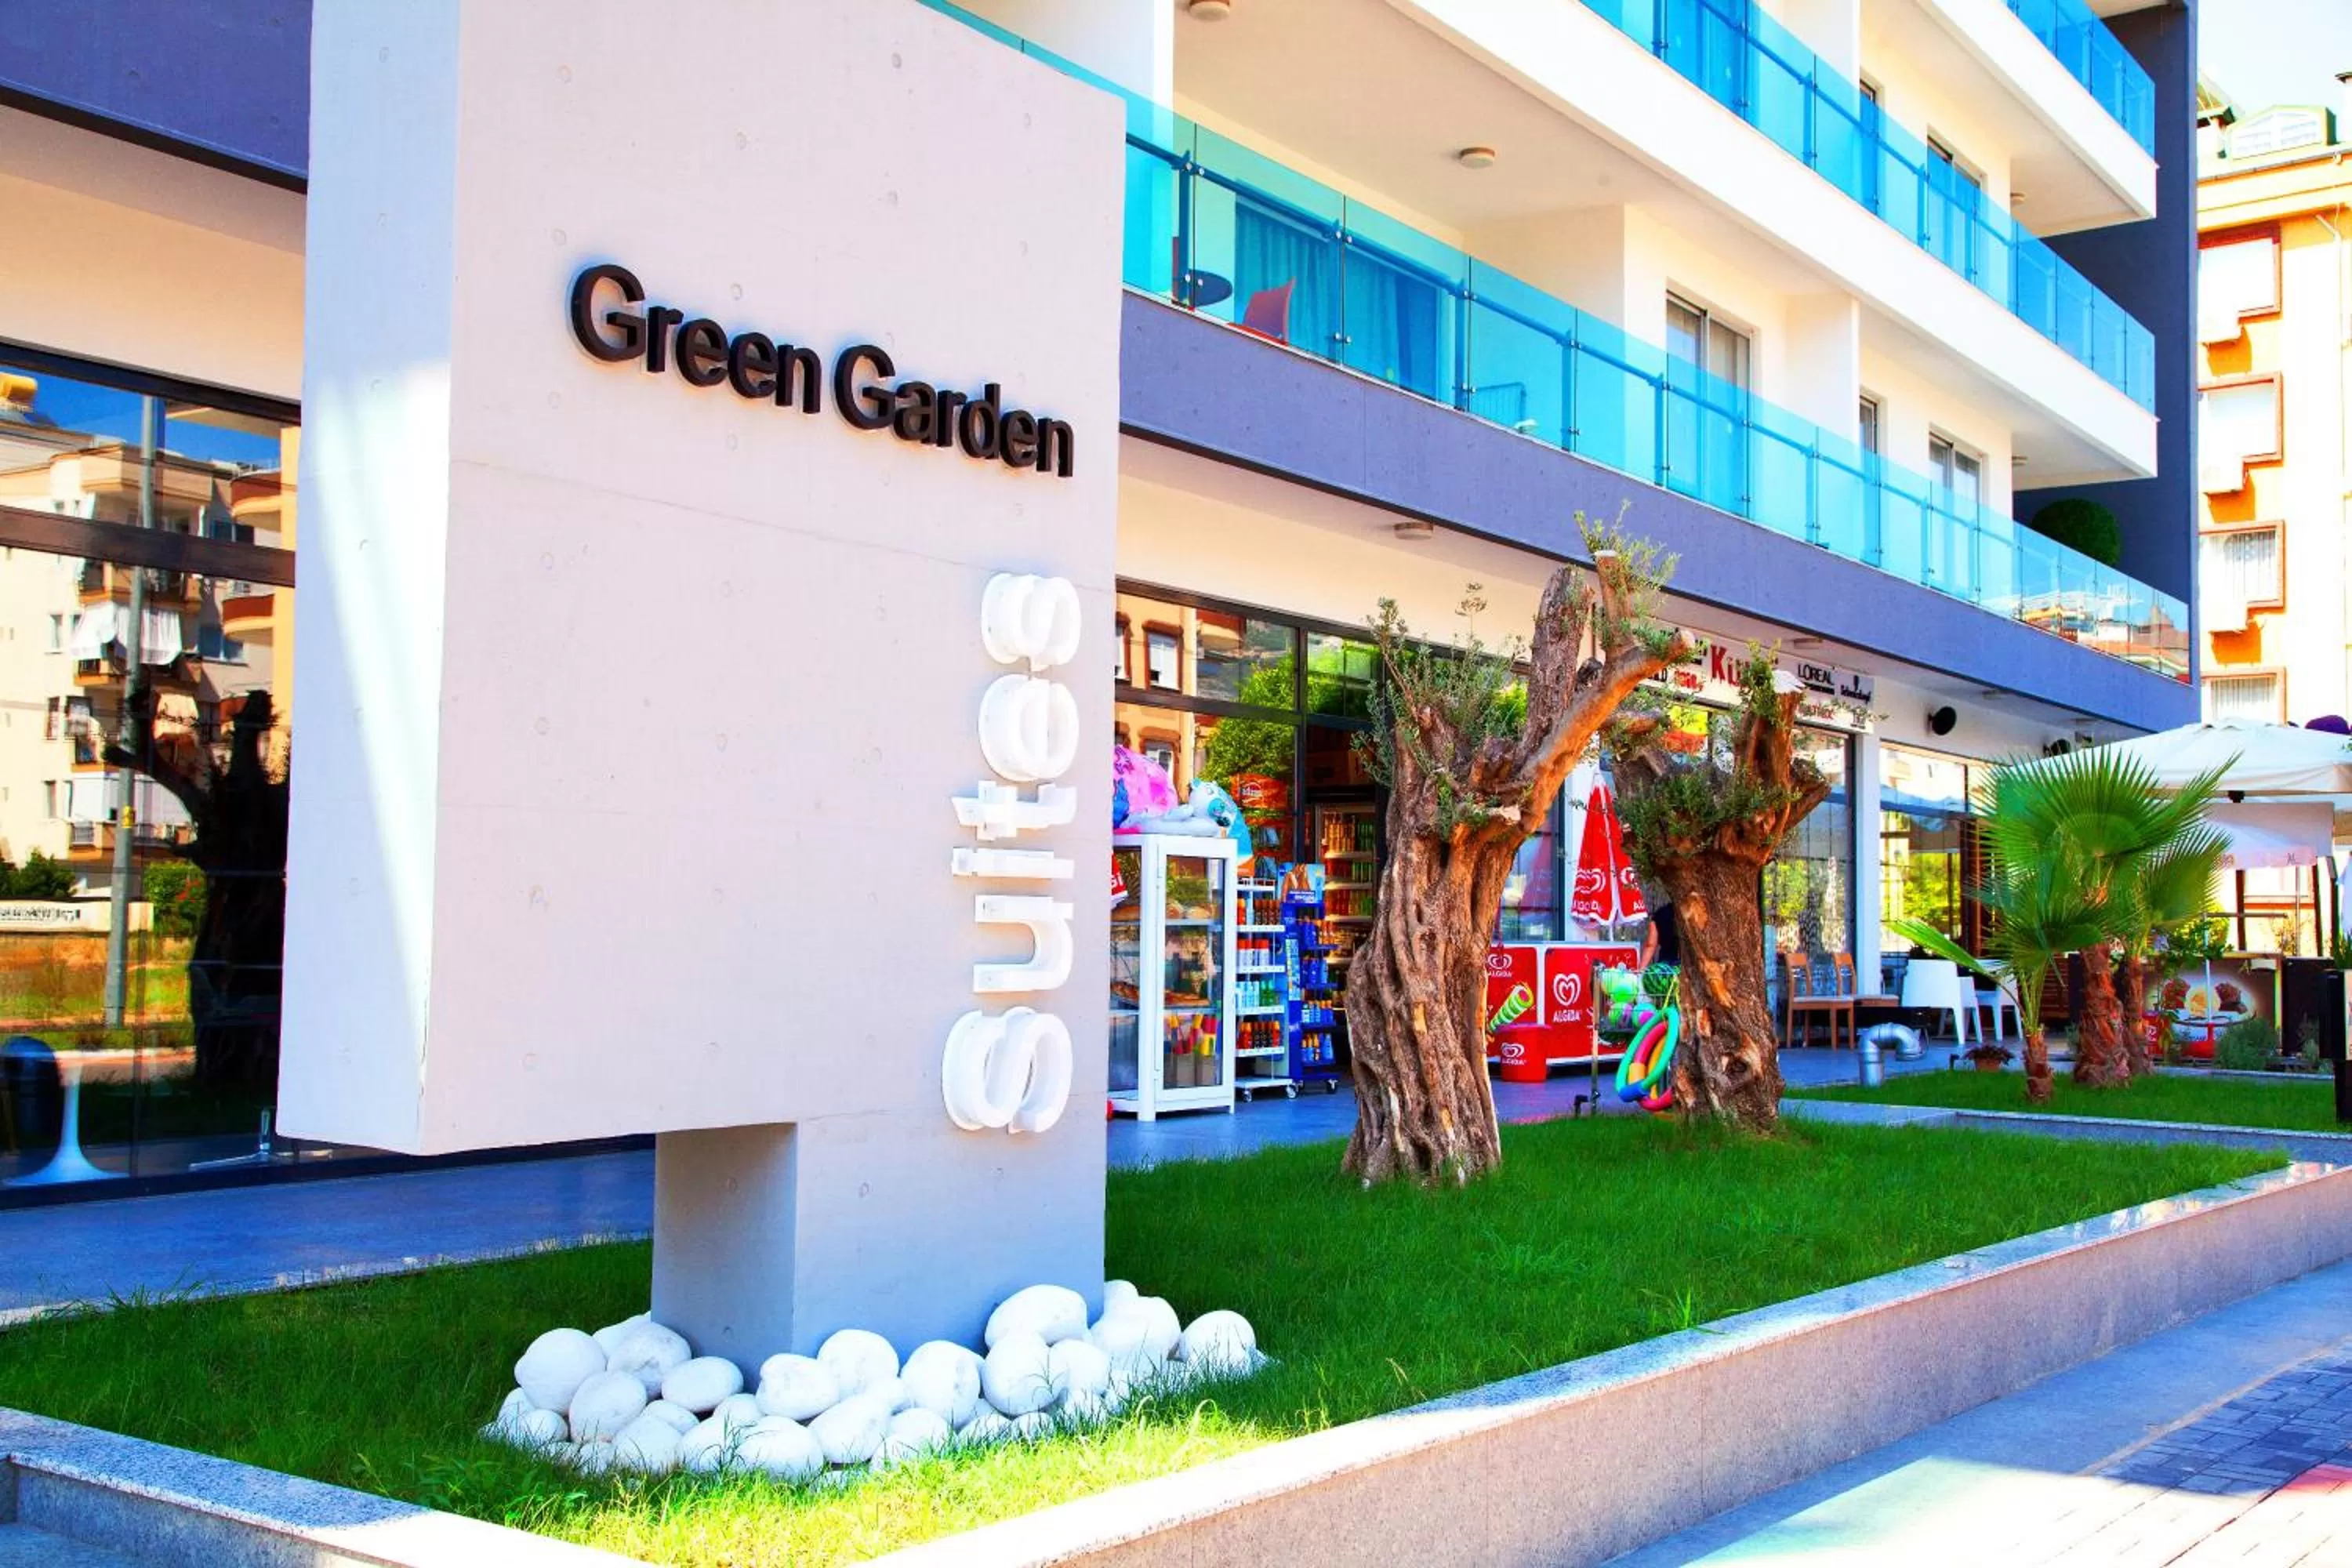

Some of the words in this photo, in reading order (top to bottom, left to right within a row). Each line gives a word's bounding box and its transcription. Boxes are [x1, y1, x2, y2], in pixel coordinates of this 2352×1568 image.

[570, 263, 822, 414] Green
[834, 343, 1073, 477] Garden
[942, 572, 1081, 1134] Suites
